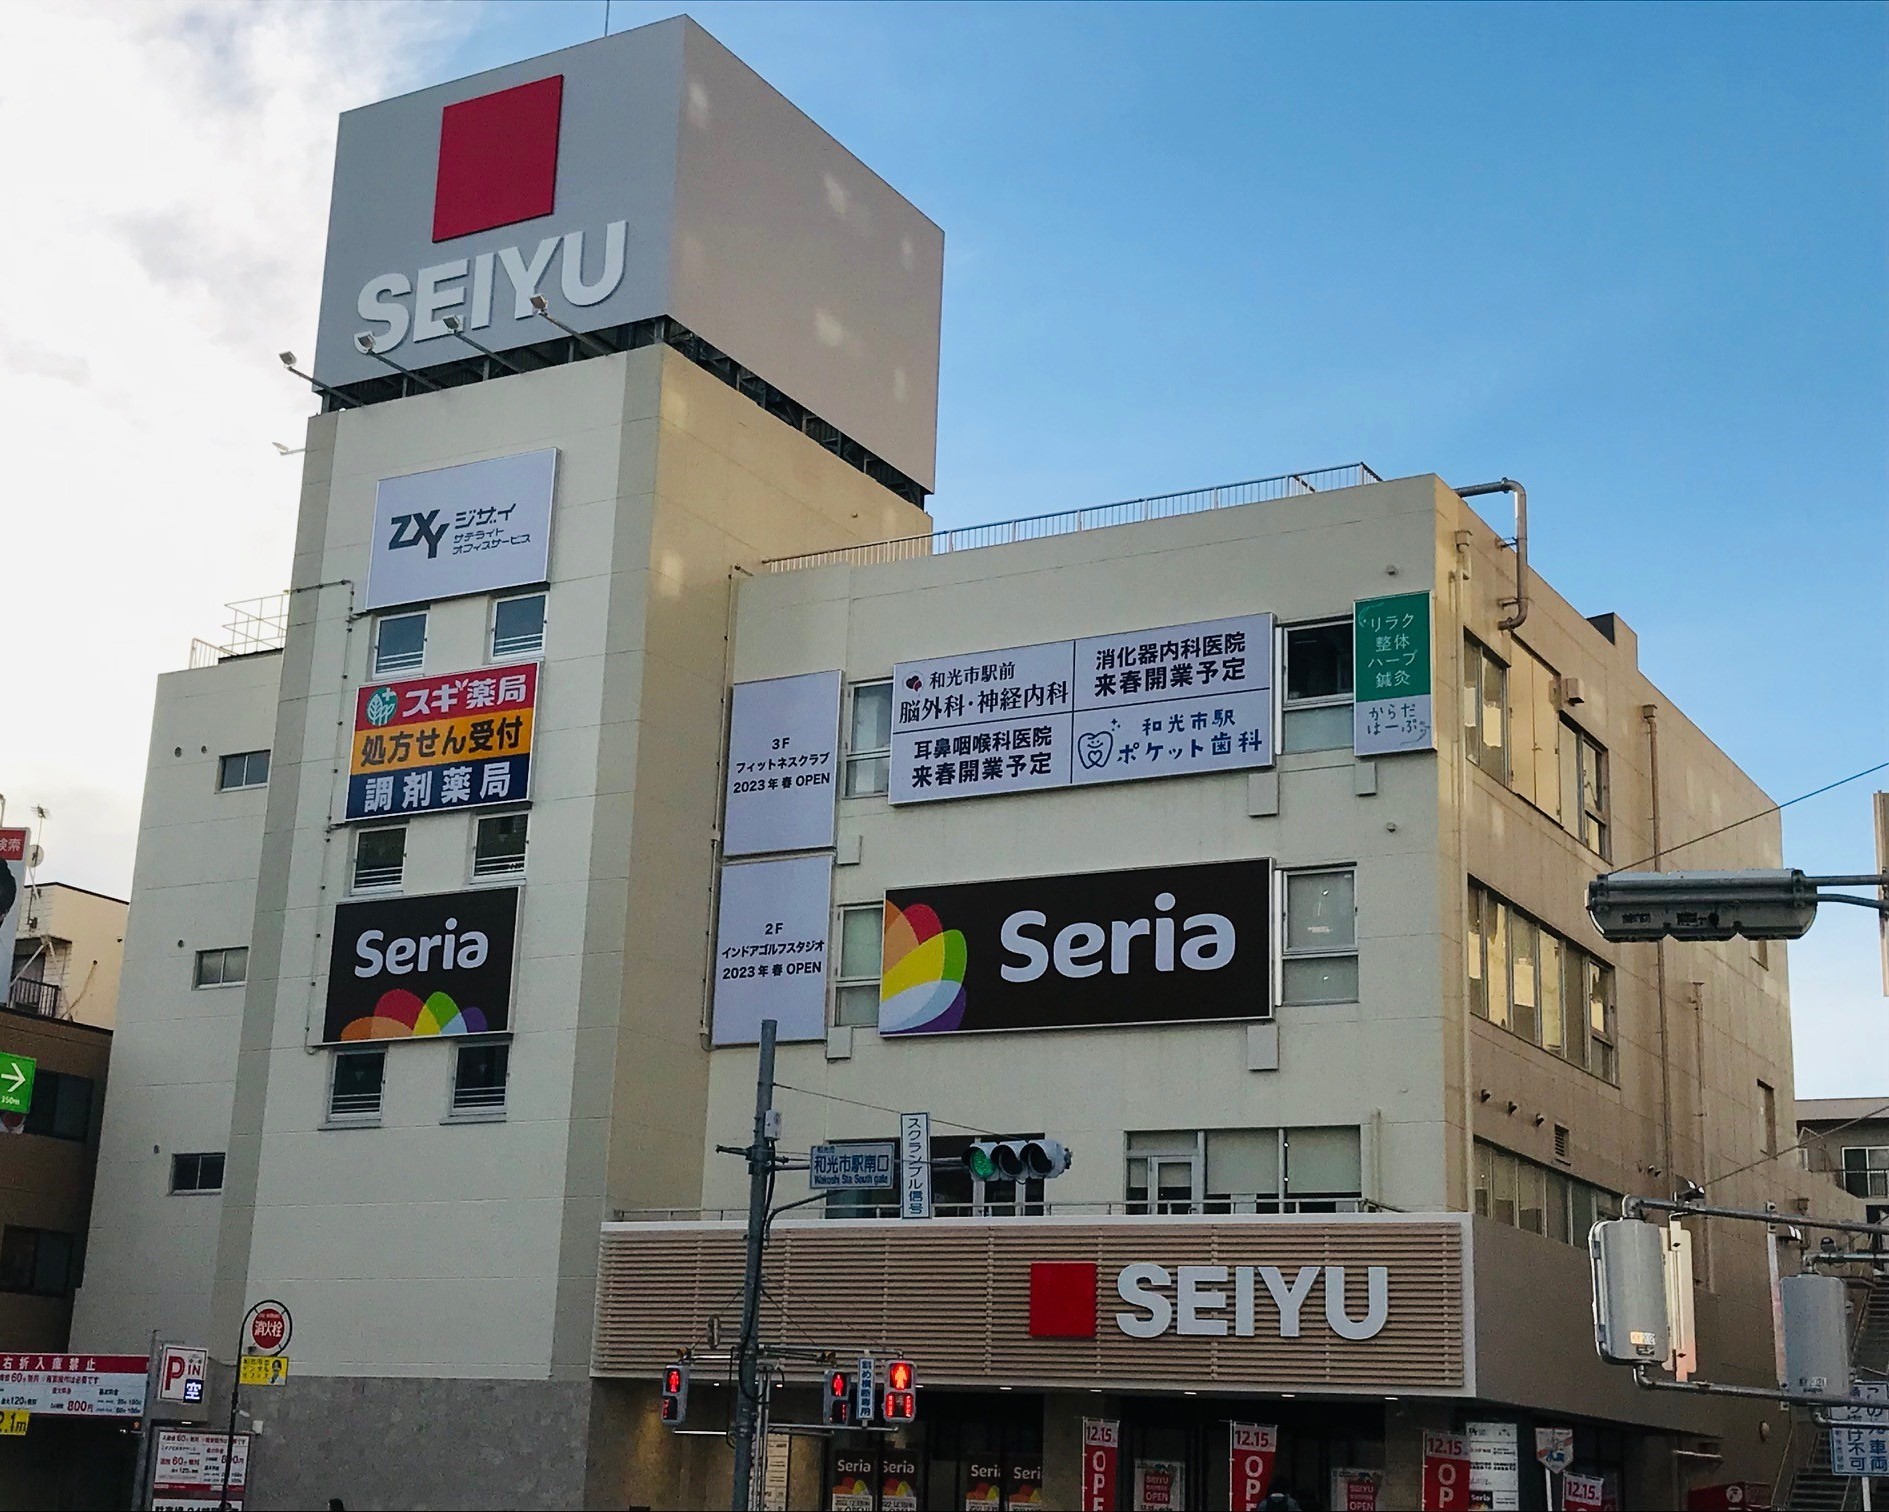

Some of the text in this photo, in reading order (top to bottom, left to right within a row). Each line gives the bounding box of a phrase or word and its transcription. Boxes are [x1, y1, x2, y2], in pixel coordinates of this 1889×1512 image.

[354, 220, 629, 354] SEIYU
[455, 503, 516, 530] ジザイ
[388, 509, 450, 559] ZXY
[452, 533, 531, 555] オフィスサービス
[453, 528, 504, 544] サテライト
[1371, 613, 1414, 632] リラク
[1095, 631, 1246, 671] 消化器内科医院
[1376, 633, 1410, 652] 整体
[1368, 650, 1418, 668] ハーブ
[929, 661, 1016, 690] 和光市駅前
[1094, 657, 1246, 698] 来春開業予定
[1376, 670, 1410, 689] 鍼灸
[402, 674, 527, 718] スギ薬局
[899, 681, 1069, 724] 脳外科・神経内科
[1142, 708, 1236, 736] 和光市駅
[1369, 703, 1416, 721] からだ
[1367, 719, 1418, 735] はーぶ
[360, 715, 523, 767] 処方せん受付
[772, 737, 790, 750] 3F
[914, 726, 1052, 760] 耳鼻咽喉科医院
[1117, 729, 1263, 764] ポケット歯科
[736, 752, 830, 773] フィットネスクラブ
[912, 752, 1052, 788] 来春開業予定
[364, 761, 511, 813] 調剤薬局
[795, 772, 830, 787] OPEN
[765, 923, 784, 935] 2F
[1000, 892, 1236, 983] Seria
[354, 917, 489, 979] Seria
[721, 939, 825, 960] インドアゴルフスタジオ
[786, 960, 822, 975] OPEN
[814, 1154, 890, 1173] 和光市駅南口
[907, 1116, 924, 1215] スクランブル信号
[1115, 1262, 1389, 1340] SEIYU
[254, 1320, 283, 1338] 消火栓
[165, 1356, 185, 1391] P
[188, 1364, 201, 1376] IN
[185, 1382, 202, 1400] 空
[1235, 1430, 1269, 1447] 12.15
[837, 1459, 871, 1473] Seria
[970, 1464, 1000, 1478] Seri
[1013, 1466, 1041, 1479] Seri
[1146, 1491, 1169, 1501] OPEN
[1567, 1481, 1596, 1500] 12.15
